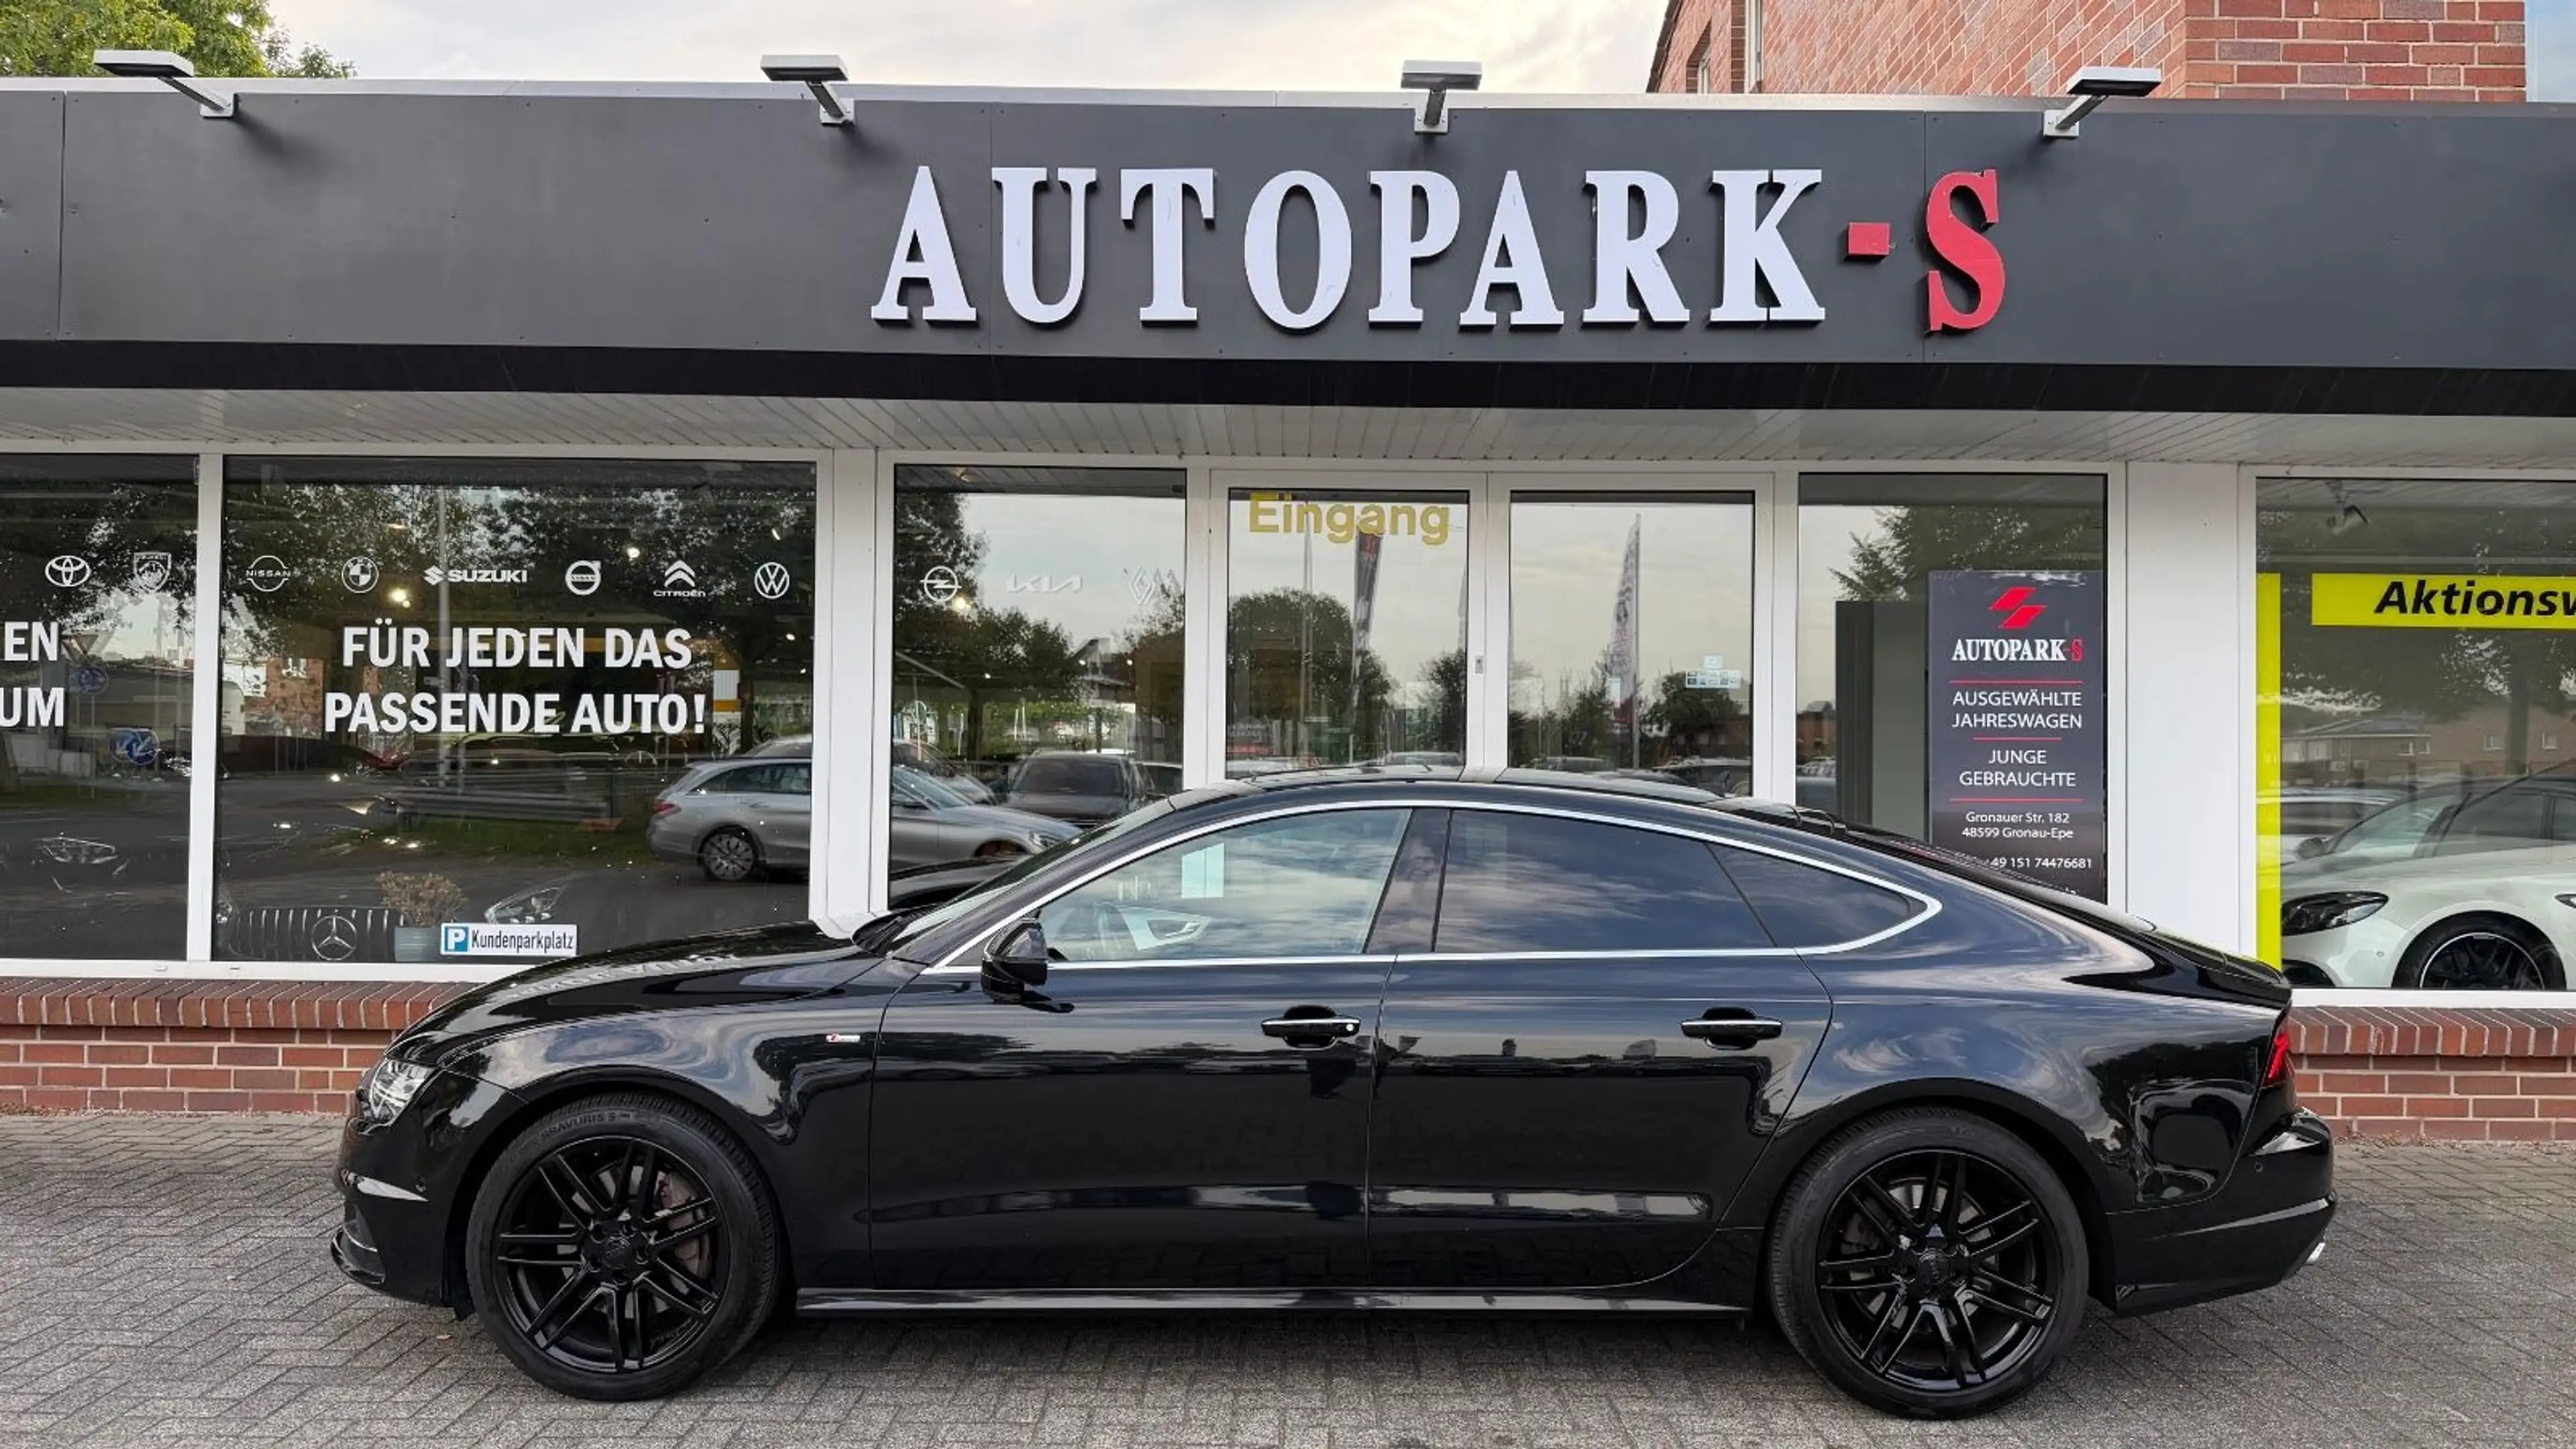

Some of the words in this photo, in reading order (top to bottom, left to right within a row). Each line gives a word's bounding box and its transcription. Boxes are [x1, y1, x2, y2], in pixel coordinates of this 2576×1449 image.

[871, 166, 2005, 333] AUTOPARK-S
[1250, 492, 1450, 545] Eingang
[246, 569, 291, 578] NISSAN
[447, 569, 527, 582] SUZUKI
[5, 621, 59, 661] EN
[343, 618, 430, 667] FÜR
[446, 627, 584, 668] JEDEN
[605, 628, 692, 669] DAS
[1951, 639, 2083, 663] AUTOPARK-S
[1952, 689, 2082, 706] AUSGEWÄHLTE
[0, 687, 64, 727] UM
[325, 692, 562, 734] PASSENDE
[571, 694, 706, 734] AUTO!
[1951, 712, 2082, 729] JAHRESWAGEN
[1988, 749, 2047, 765] JUNGE
[1959, 771, 2076, 787] GEBRAUCHTE
[1966, 811, 2022, 822] Gronauer
[2025, 812, 2045, 824] Str.
[2049, 812, 2070, 824] 182
[1962, 827, 2000, 838] 48599
[2002, 828, 2074, 841] Gronau-Epe
[2011, 857, 2031, 868] 151
[2035, 857, 2092, 869] 74476681
[447, 928, 466, 951] P
[472, 930, 574, 953] Kundenparkplatz
